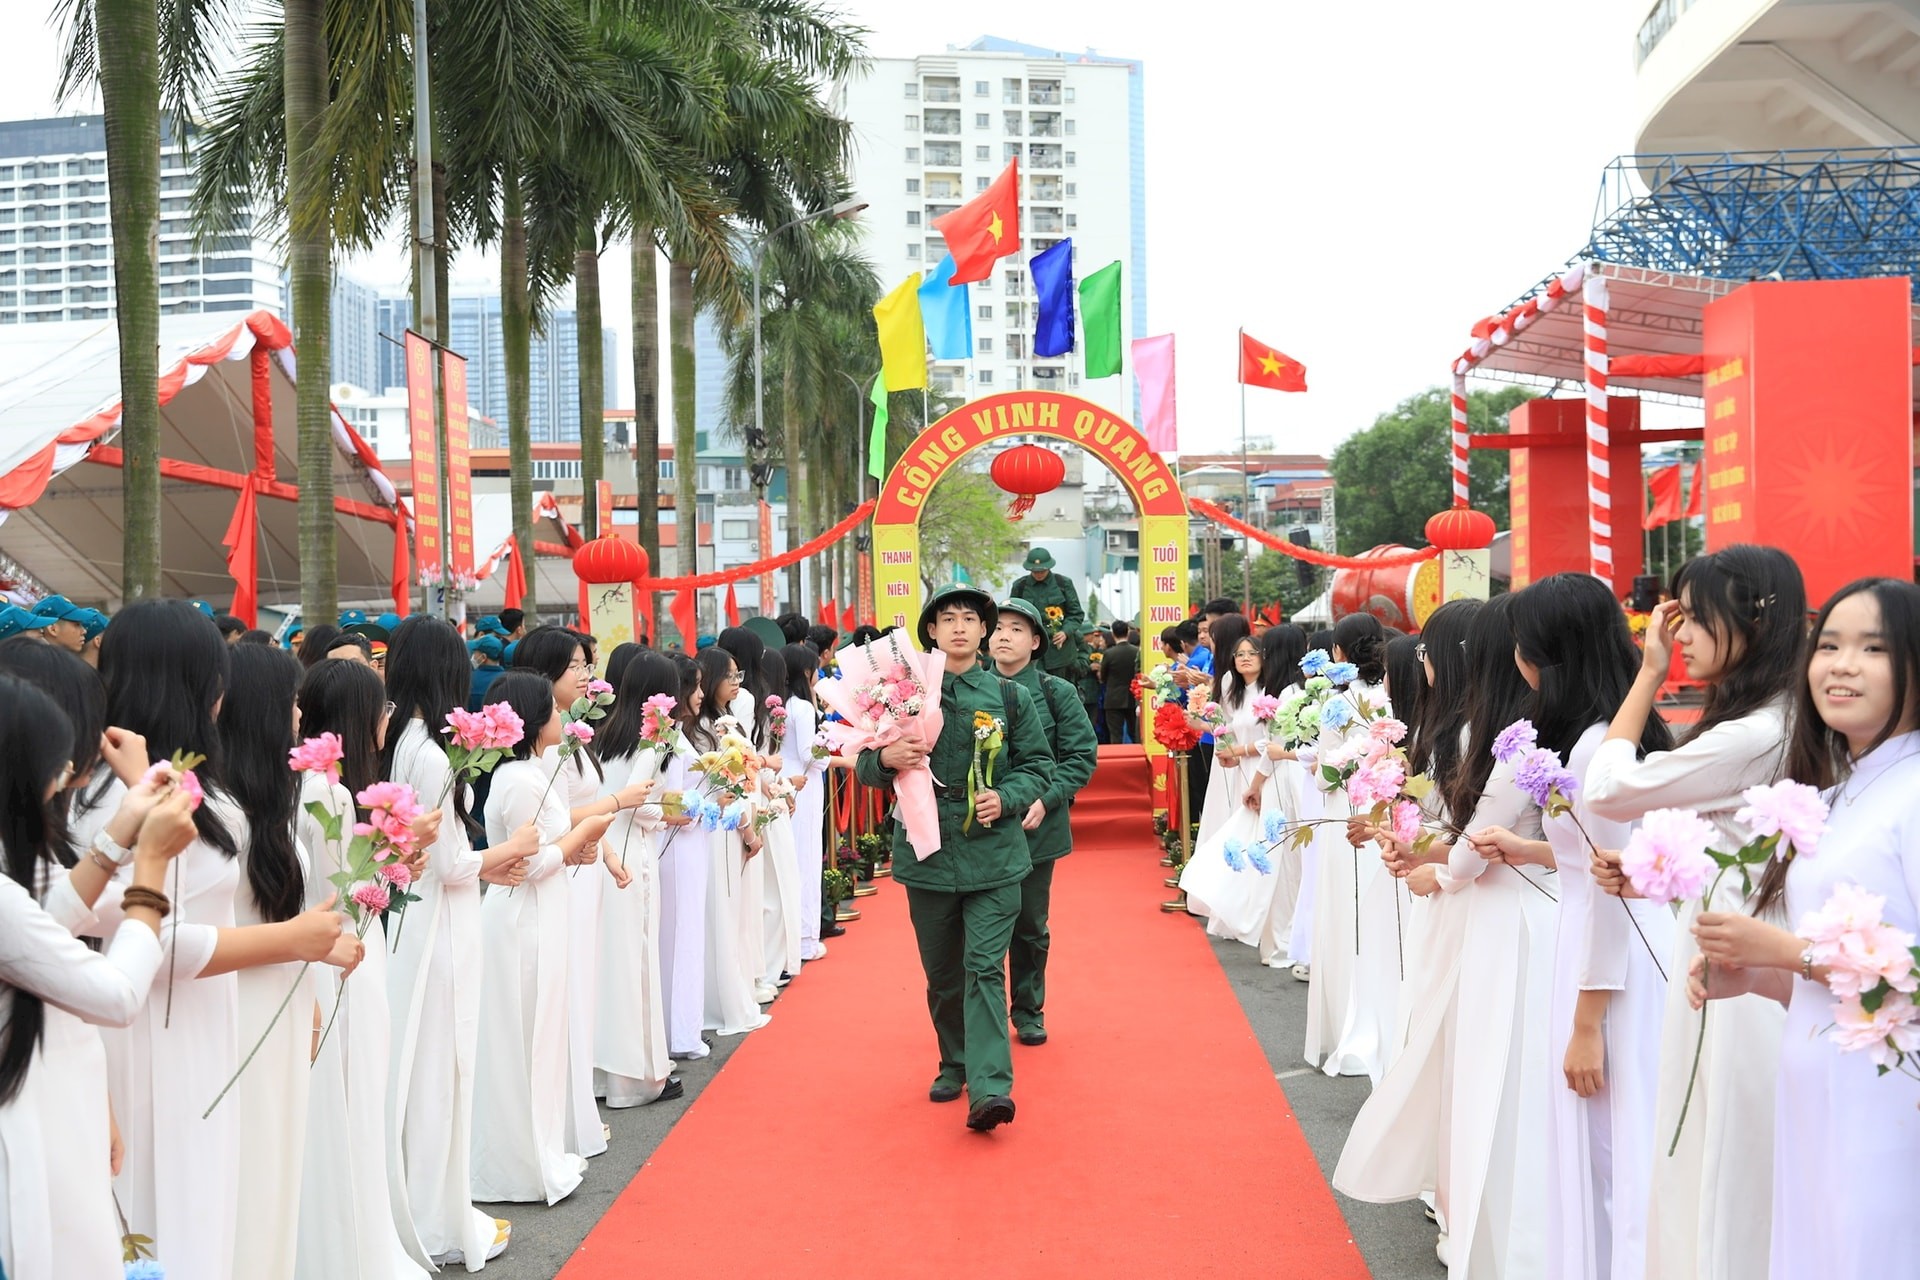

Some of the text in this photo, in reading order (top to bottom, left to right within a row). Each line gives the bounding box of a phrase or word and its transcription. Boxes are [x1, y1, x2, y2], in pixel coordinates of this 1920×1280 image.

[896, 402, 1169, 508] CỔNG VINH QUANG
[881, 551, 912, 564] THANH
[1152, 541, 1178, 562] TUỔI
[887, 580, 910, 596] NIÊN
[1155, 571, 1176, 592] TRẺ
[1150, 606, 1181, 622] XUNG
